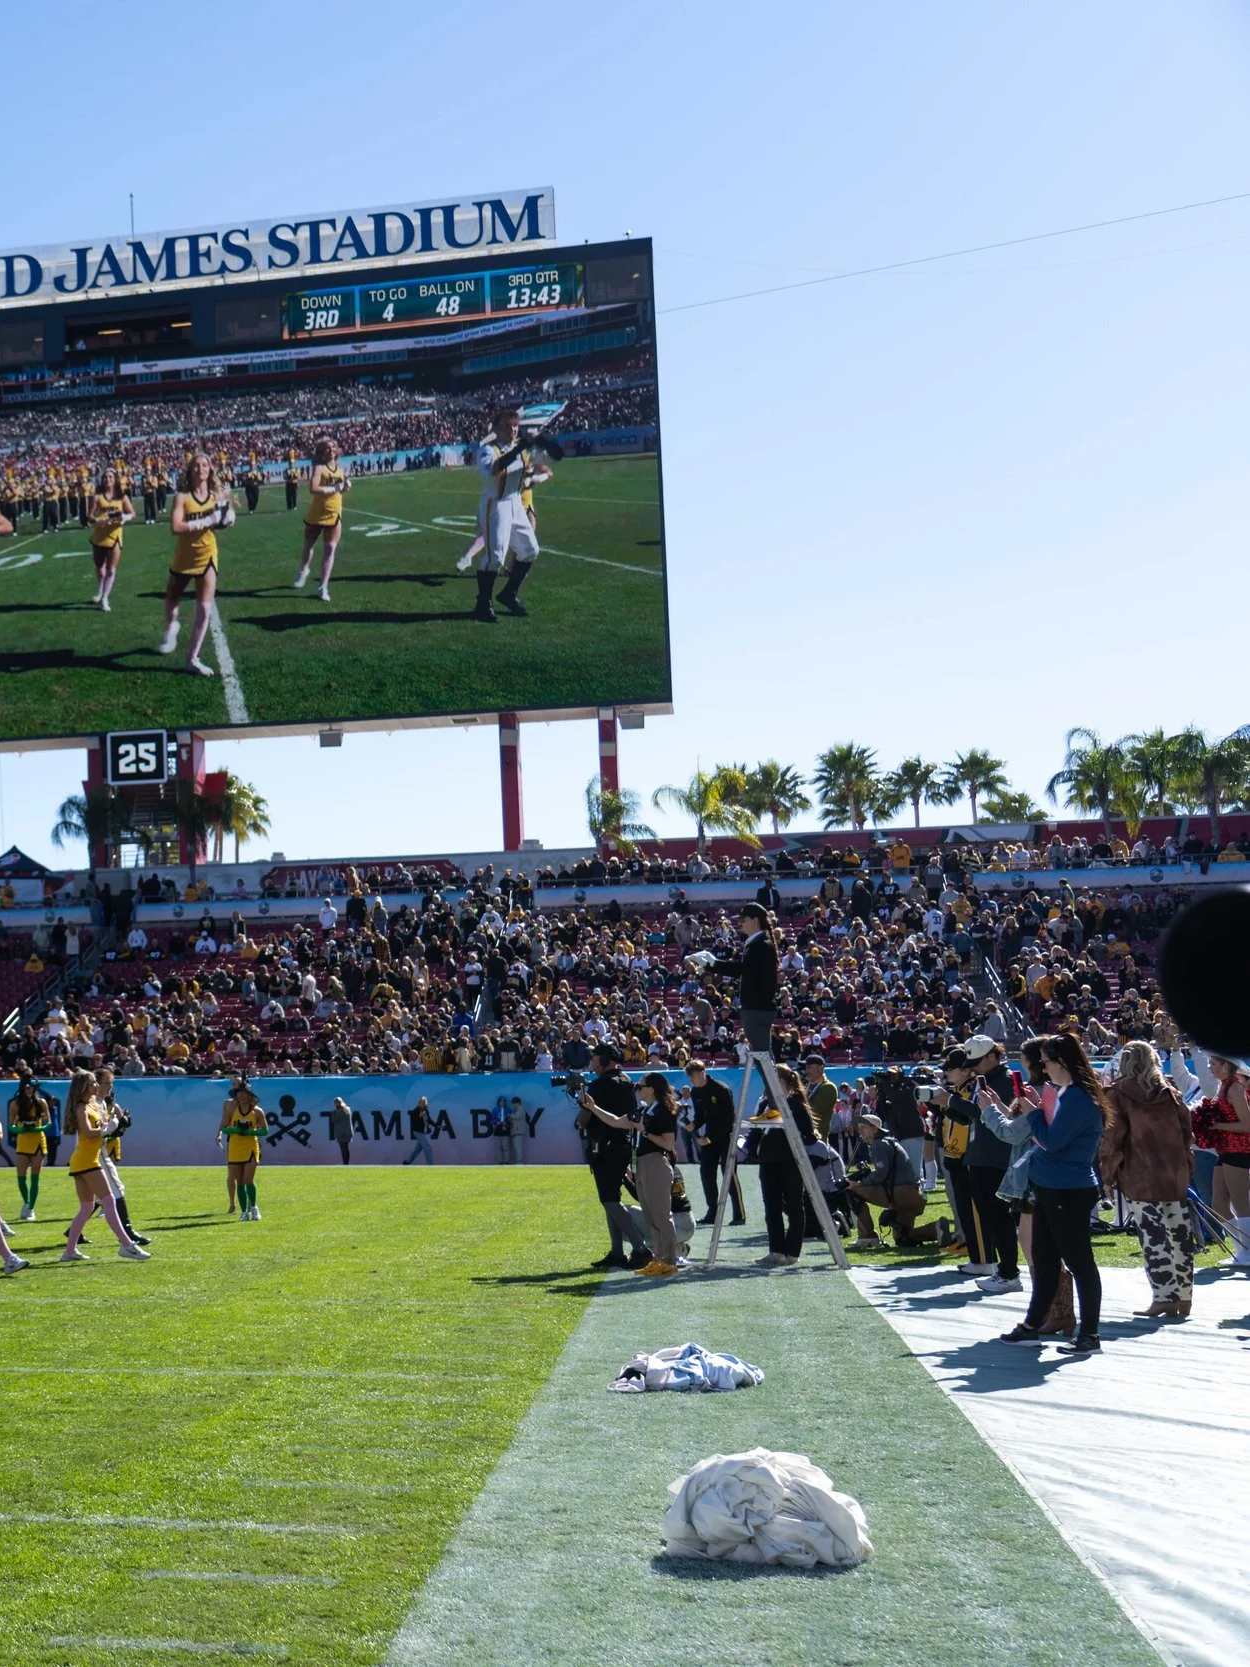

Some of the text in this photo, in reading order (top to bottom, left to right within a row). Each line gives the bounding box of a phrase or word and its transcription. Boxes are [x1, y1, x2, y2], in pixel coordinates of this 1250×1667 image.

[53, 228, 252, 293] JAMES
[267, 194, 547, 269] STADIUM
[419, 280, 474, 297] BALL ON
[508, 271, 558, 287] 3RD QTR
[301, 295, 341, 310] DOWN
[369, 287, 406, 302] TO GO
[506, 285, 561, 309] 13:43
[382, 303, 394, 322] 4
[436, 295, 460, 316] 48
[304, 309, 339, 330] 3RD
[601, 434, 638, 446] GEICO
[118, 742, 156, 774] 25
[320, 1108, 545, 1141] TAMA BY
